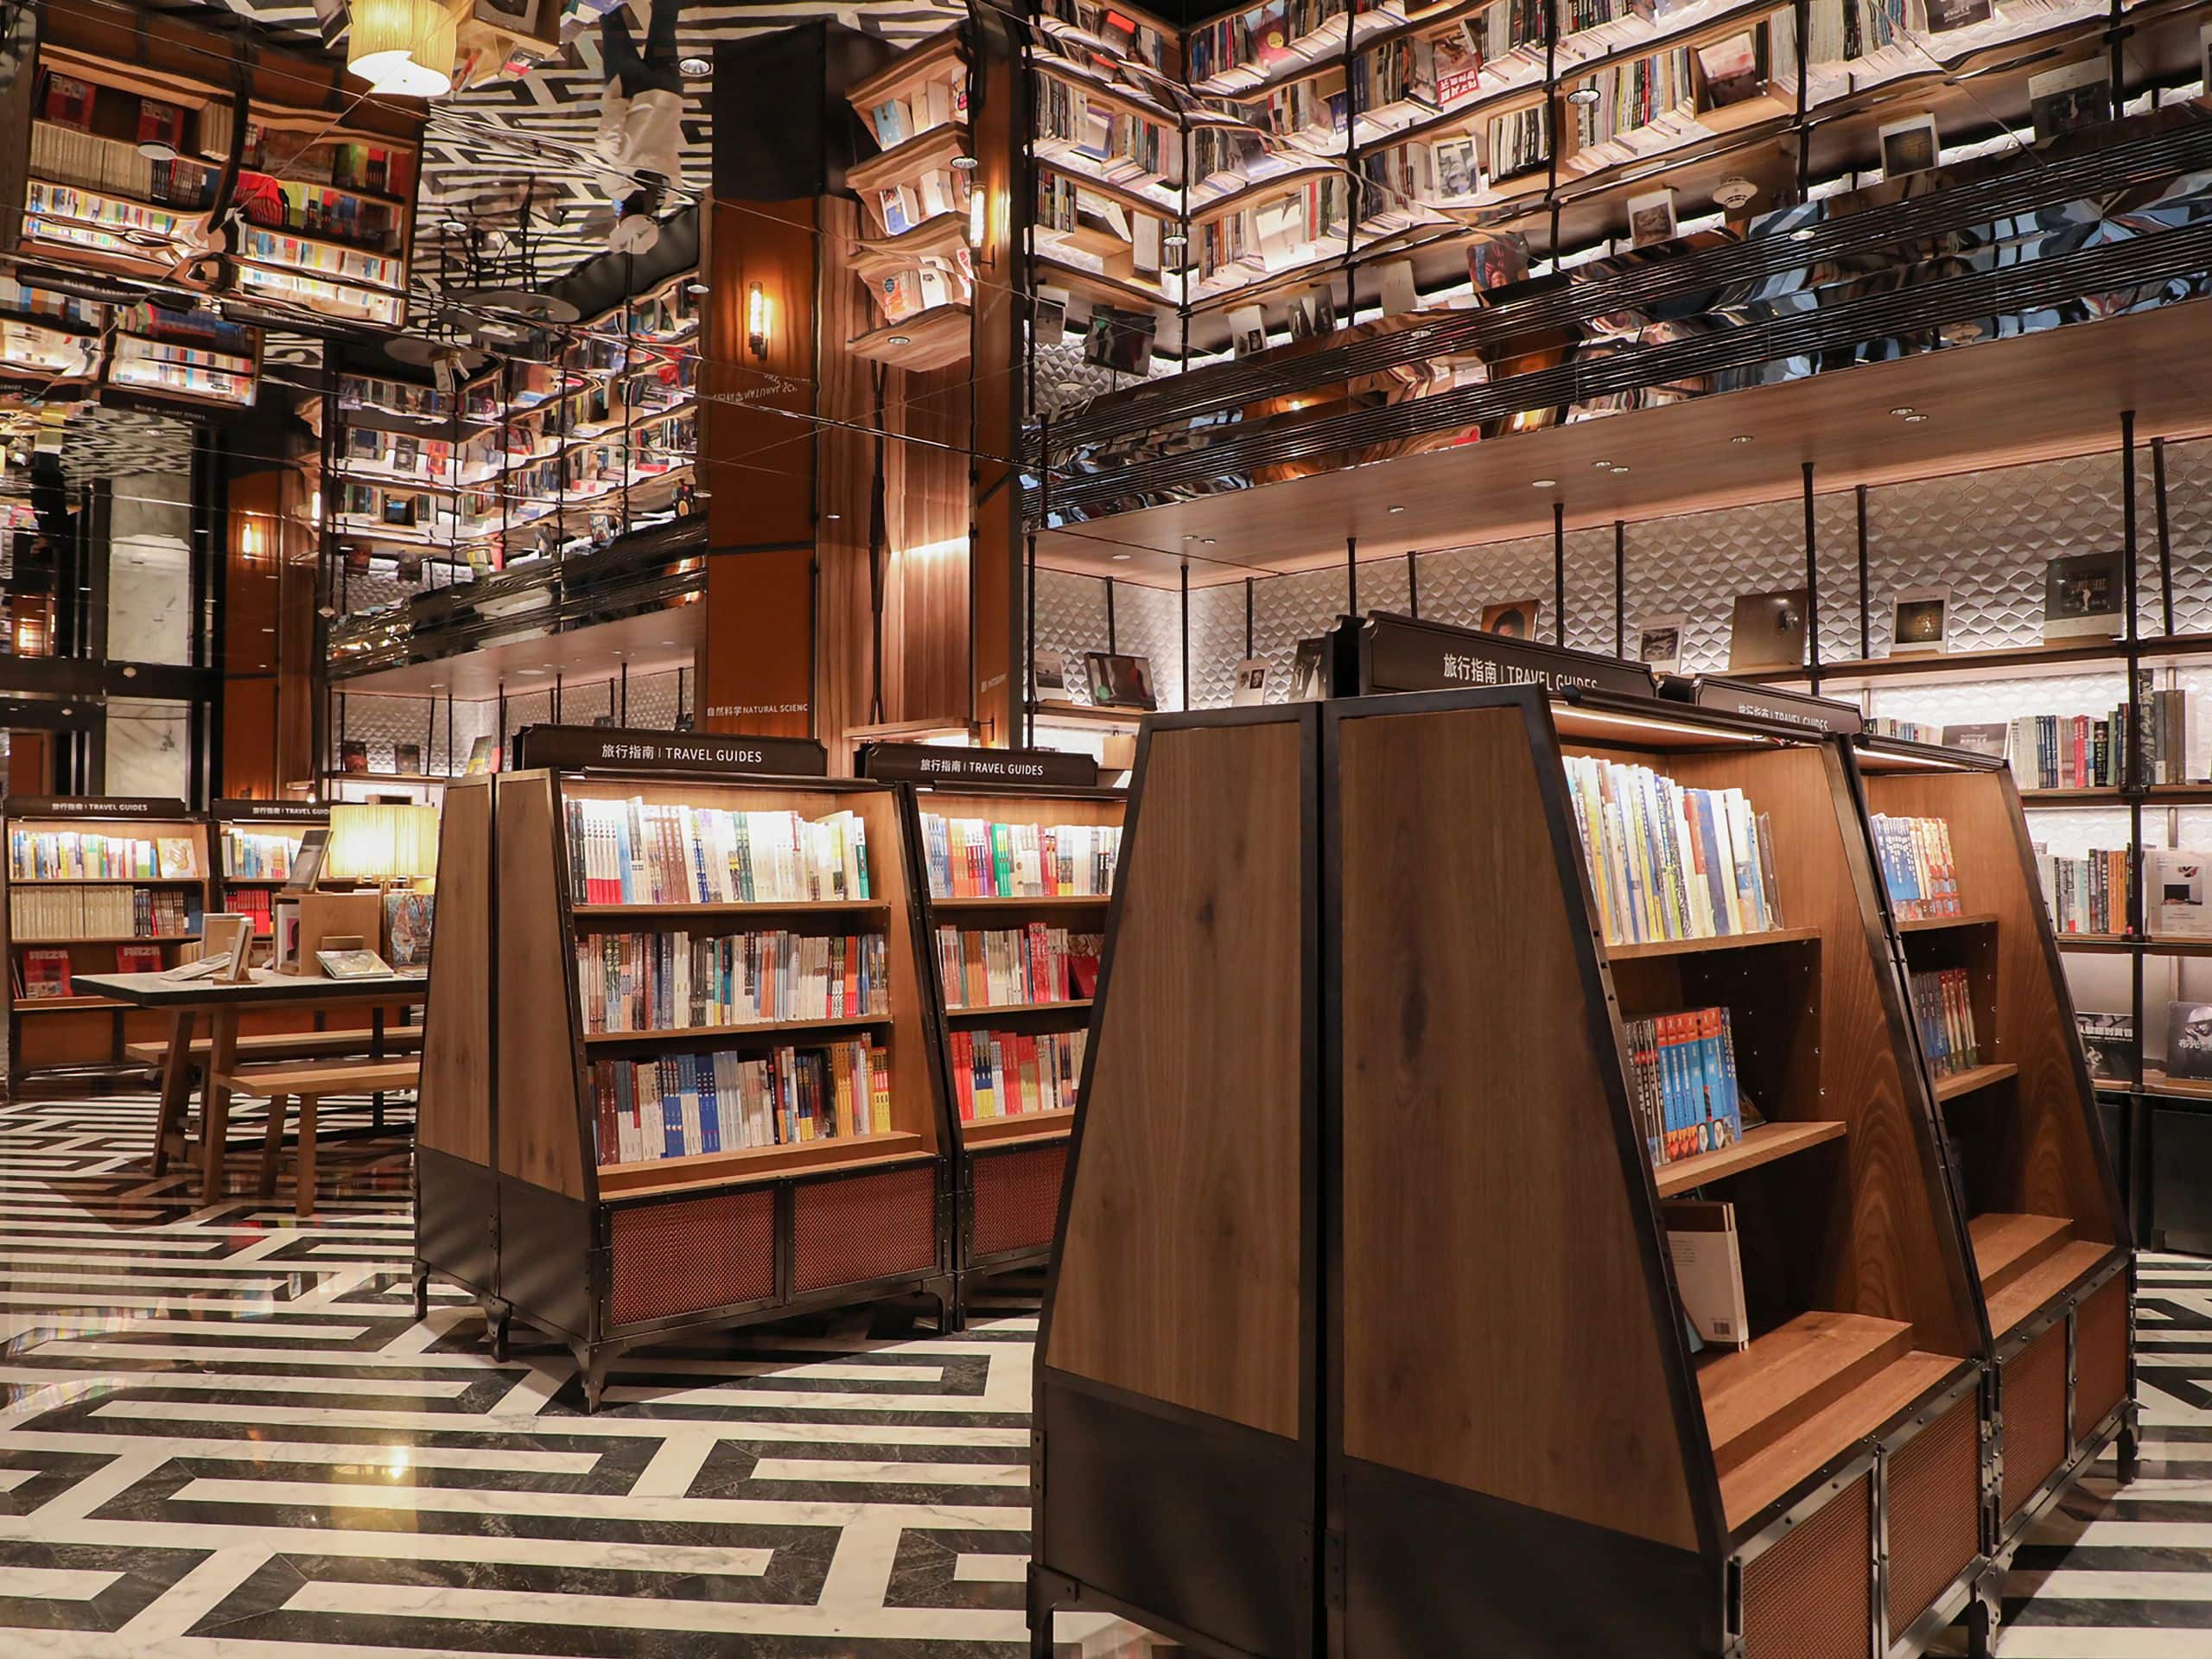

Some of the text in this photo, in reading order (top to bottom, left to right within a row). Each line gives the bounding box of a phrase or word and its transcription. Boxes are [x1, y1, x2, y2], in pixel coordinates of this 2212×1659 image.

[1443, 652, 1497, 684] 旅行指南
[1507, 665, 1554, 691] TRAVEL
[742, 704, 779, 714] NATURAL
[780, 703, 809, 713] SCIENC
[601, 744, 763, 763] 旅行指南 TRAVEL GUIDES
[920, 758, 1045, 776] 旅行指南 TRAVEL GUIDES
[89, 803, 118, 811] TRAVEL
[285, 807, 312, 816] TRAVEL
